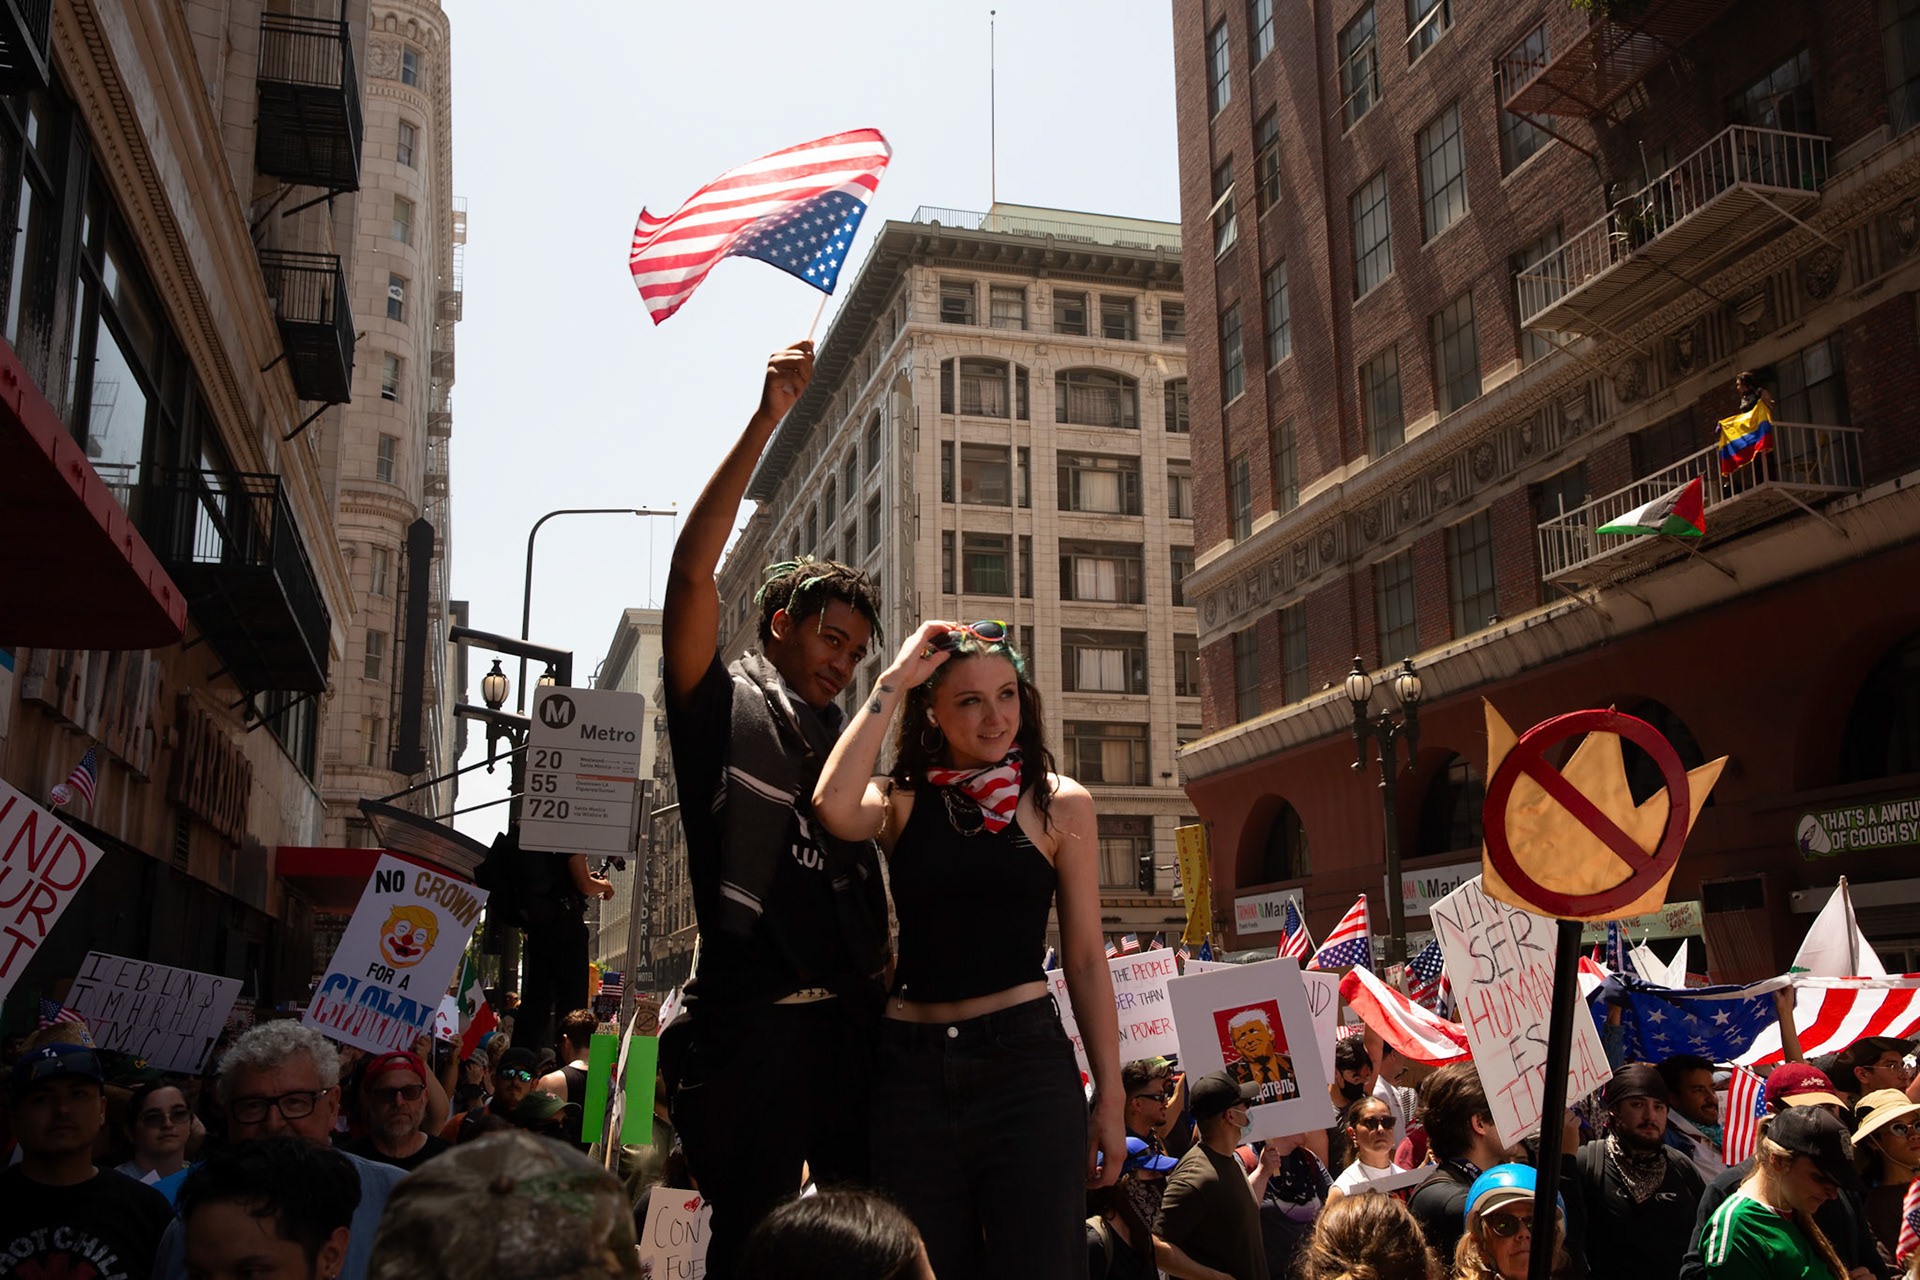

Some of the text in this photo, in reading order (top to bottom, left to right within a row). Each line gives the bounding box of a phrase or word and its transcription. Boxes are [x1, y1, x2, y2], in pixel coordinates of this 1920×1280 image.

[580, 724, 636, 743] Metro
[534, 750, 562, 770] 20
[531, 774, 558, 794] 55
[529, 799, 569, 819] 720
[1820, 808, 1866, 830] THAT'S
[1868, 806, 1878, 825] A
[1831, 830, 1847, 849] OF
[1849, 823, 1897, 848] COUGH
[375, 870, 485, 928] NO CROWN
[1469, 910, 1545, 984] SER
[81, 953, 138, 989] ICE
[366, 962, 411, 991] FOR A
[637, 971, 655, 982] HOTEL
[1112, 958, 1173, 983] THE PEOPLE
[1137, 988, 1165, 1006] THAN
[313, 972, 434, 1051] CLOWN
[1130, 1017, 1174, 1041] POWER
